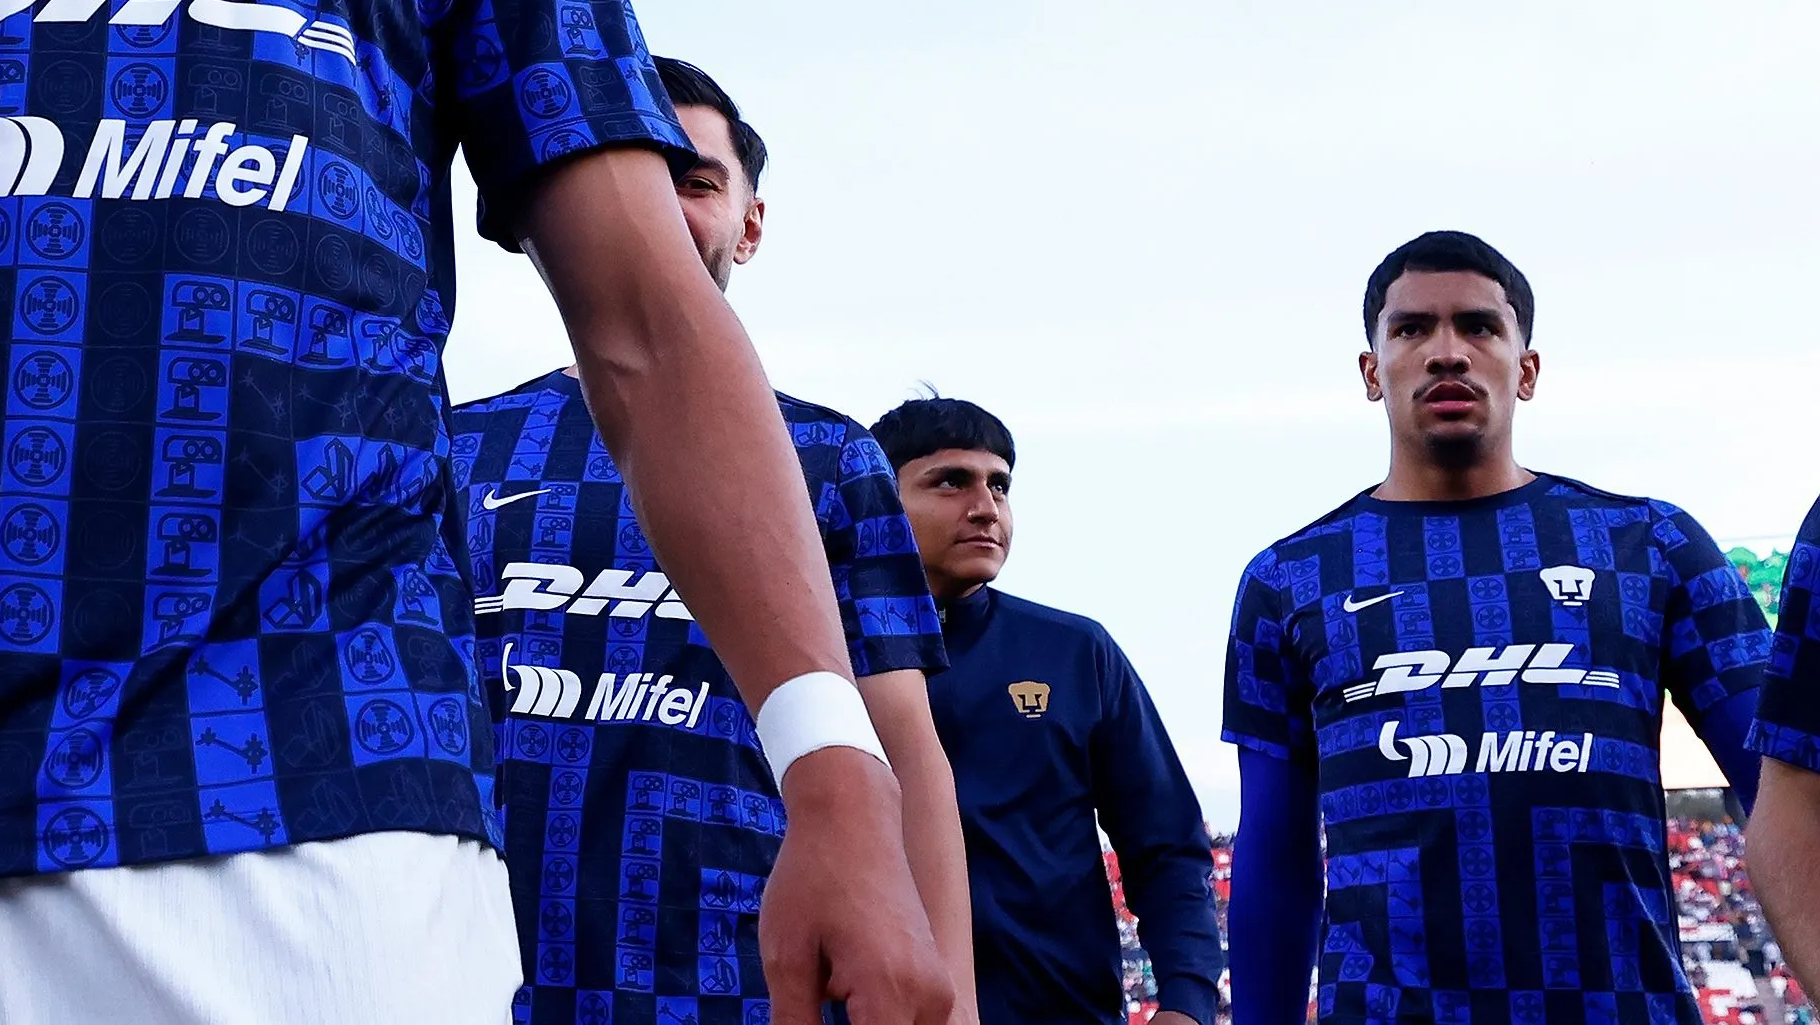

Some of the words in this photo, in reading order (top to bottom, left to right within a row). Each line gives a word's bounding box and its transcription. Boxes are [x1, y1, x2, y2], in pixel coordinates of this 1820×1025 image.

[72, 118, 309, 212] Mifel
[1370, 643, 1588, 697] DHL
[585, 671, 710, 728] Mifel
[1475, 731, 1593, 774] Mifel
